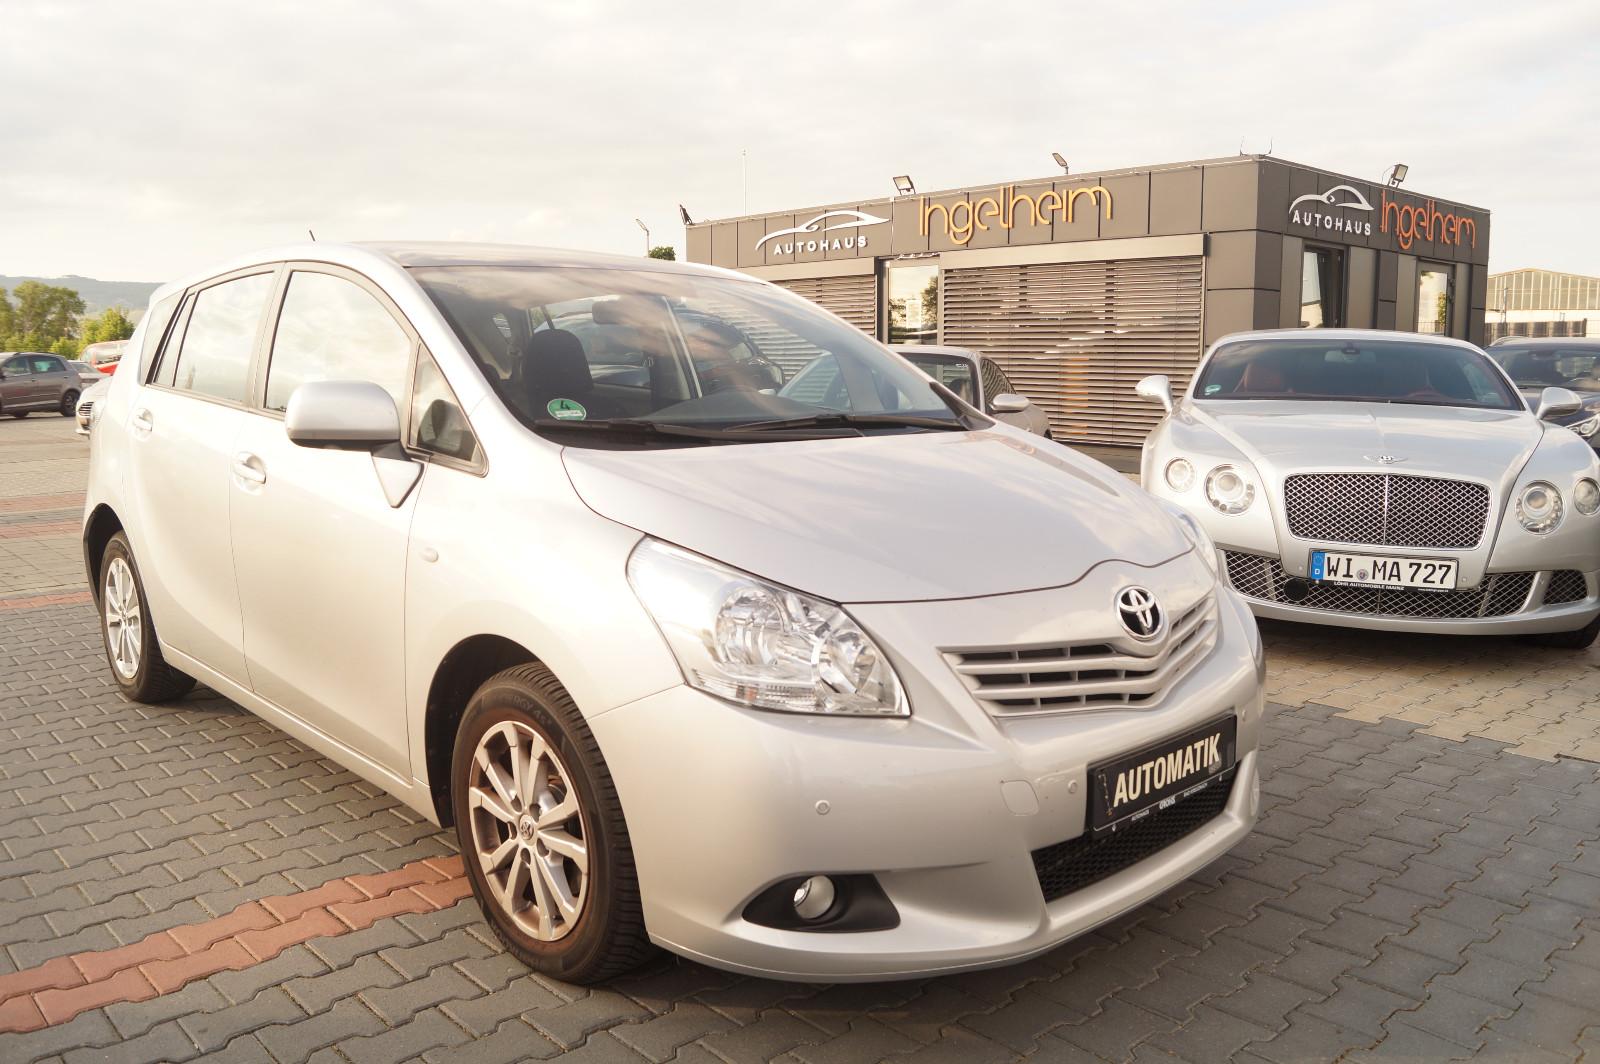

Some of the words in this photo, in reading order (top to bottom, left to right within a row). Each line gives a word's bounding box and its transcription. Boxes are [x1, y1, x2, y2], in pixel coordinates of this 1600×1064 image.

[919, 183, 1113, 245] Ingelheim
[1292, 210, 1371, 236] AUTOHAUS
[1380, 189, 1476, 250] Ingelheim
[773, 235, 868, 256] AUTOHAUS
[1326, 556, 1353, 579] WI
[1371, 559, 1402, 582] MA
[1408, 562, 1452, 585] 727
[1113, 732, 1221, 808] AUTOMATIK
